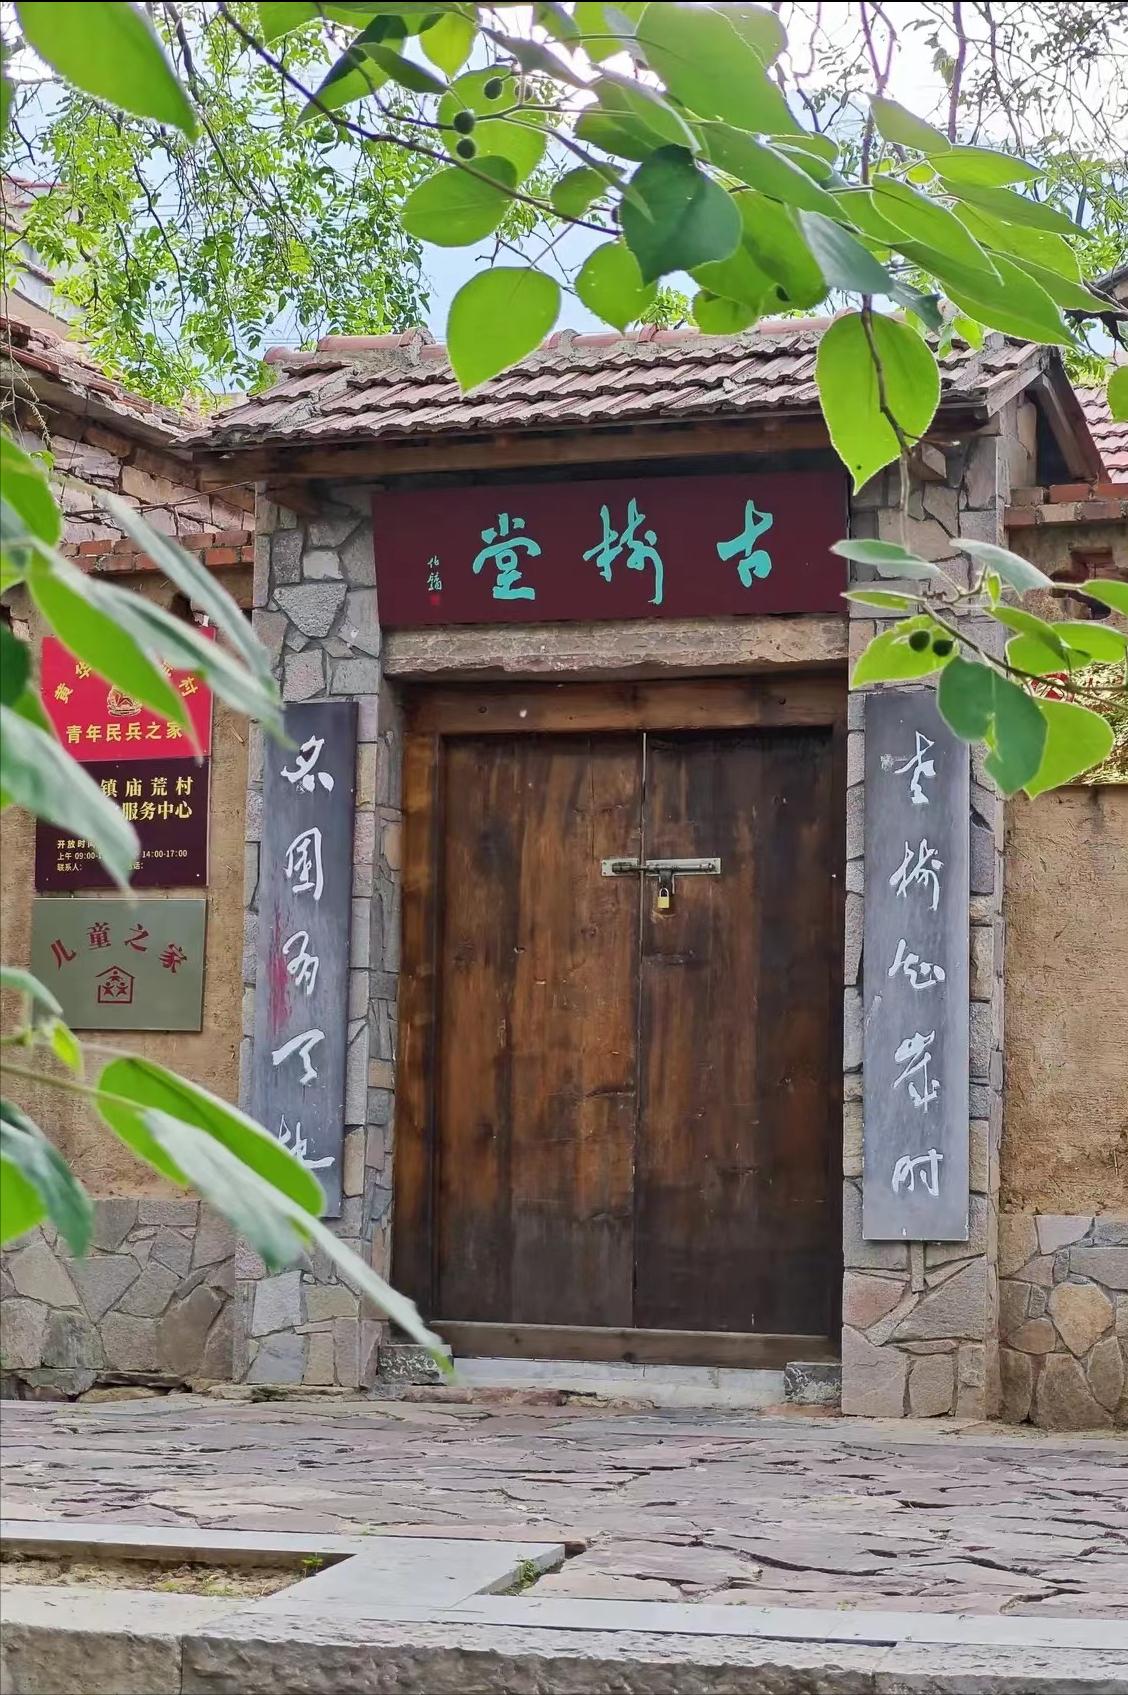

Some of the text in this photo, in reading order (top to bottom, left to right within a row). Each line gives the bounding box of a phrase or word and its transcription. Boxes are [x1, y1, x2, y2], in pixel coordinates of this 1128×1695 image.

[66, 721, 183, 744] 青年民兵之家
[100, 775, 194, 798] 镇庙荒村
[121, 800, 193, 821] 服务中心
[57, 852, 72, 861] 上午
[142, 849, 188, 858] 14:00-17:00
[50, 921, 188, 974] 儿童之家
